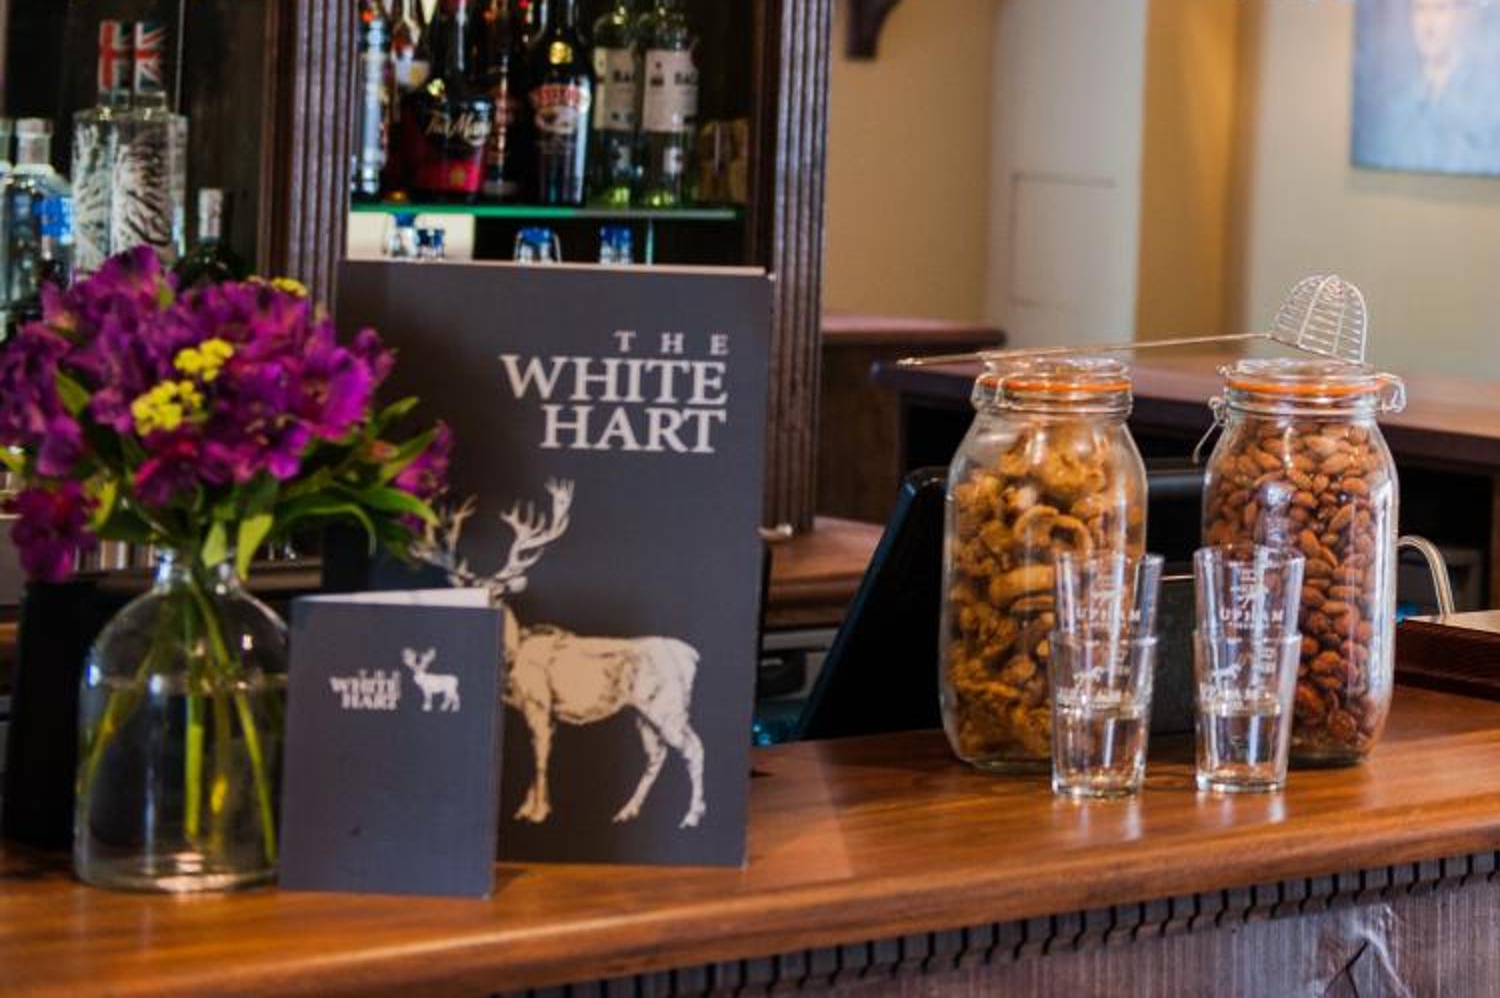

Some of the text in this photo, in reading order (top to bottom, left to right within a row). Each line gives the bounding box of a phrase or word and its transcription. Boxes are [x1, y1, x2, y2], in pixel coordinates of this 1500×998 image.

[614, 330, 730, 356] THE
[499, 354, 730, 404] WHITE
[540, 405, 728, 454] HART
